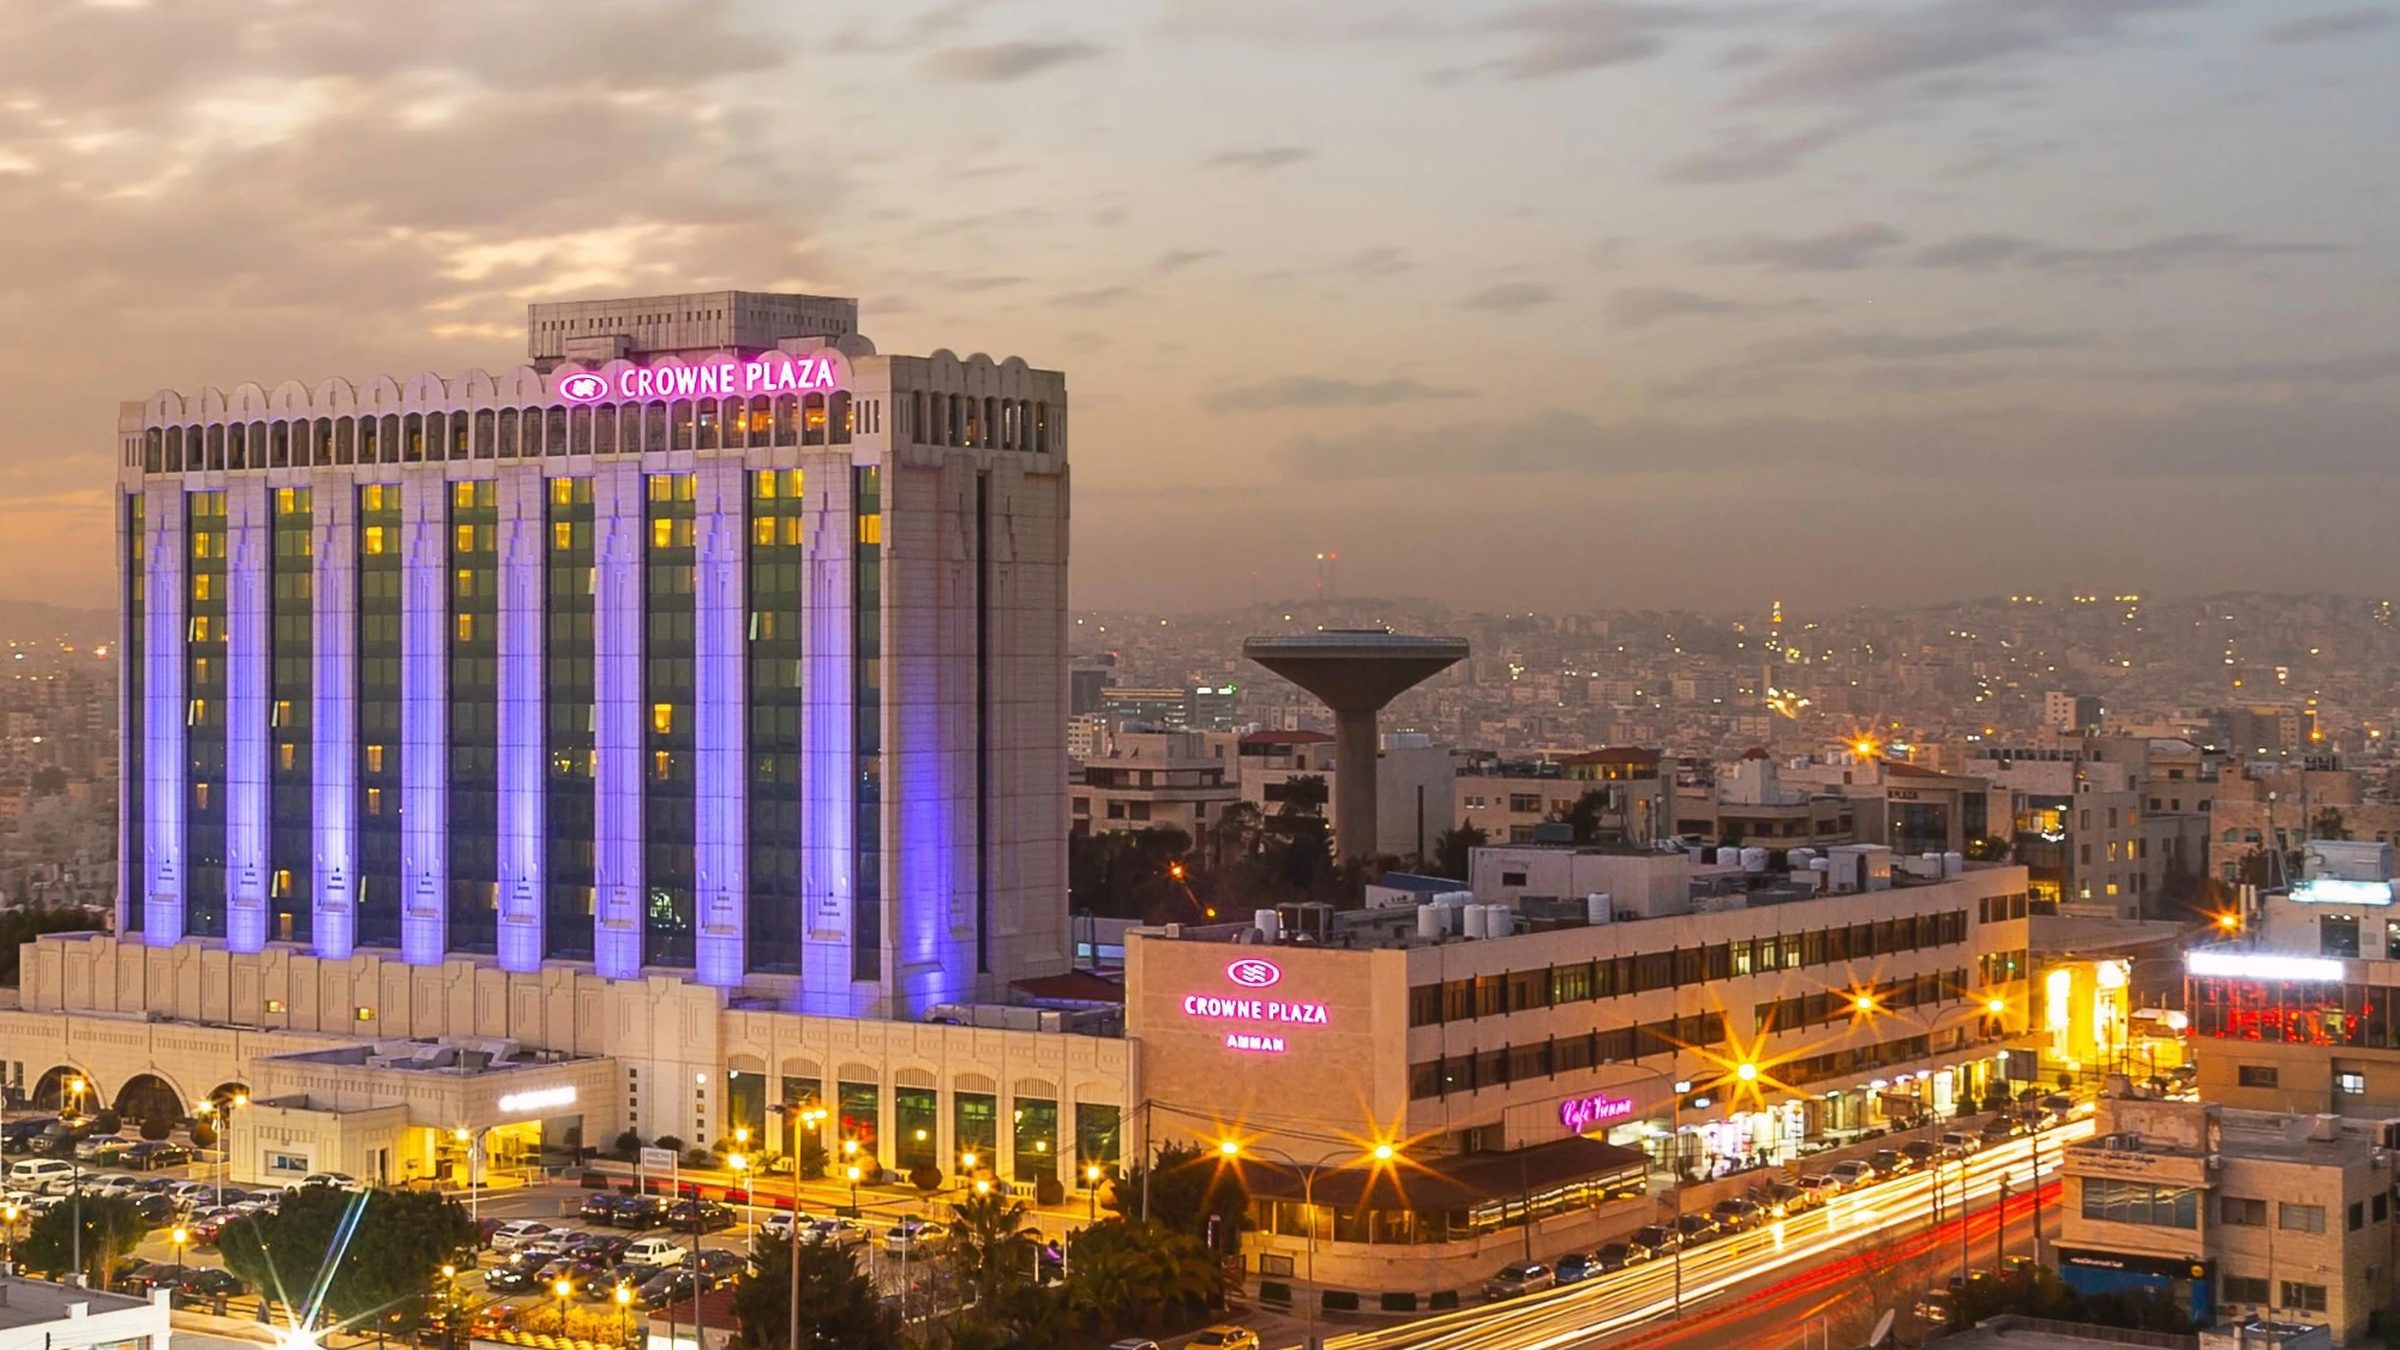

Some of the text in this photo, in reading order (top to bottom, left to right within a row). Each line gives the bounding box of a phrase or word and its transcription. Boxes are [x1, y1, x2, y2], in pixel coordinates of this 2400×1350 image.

[620, 359, 834, 396] CROWNE PLAZA
[1184, 995, 1328, 1023] CROWNE PLAZA
[1227, 1034, 1285, 1051] AMMAN
